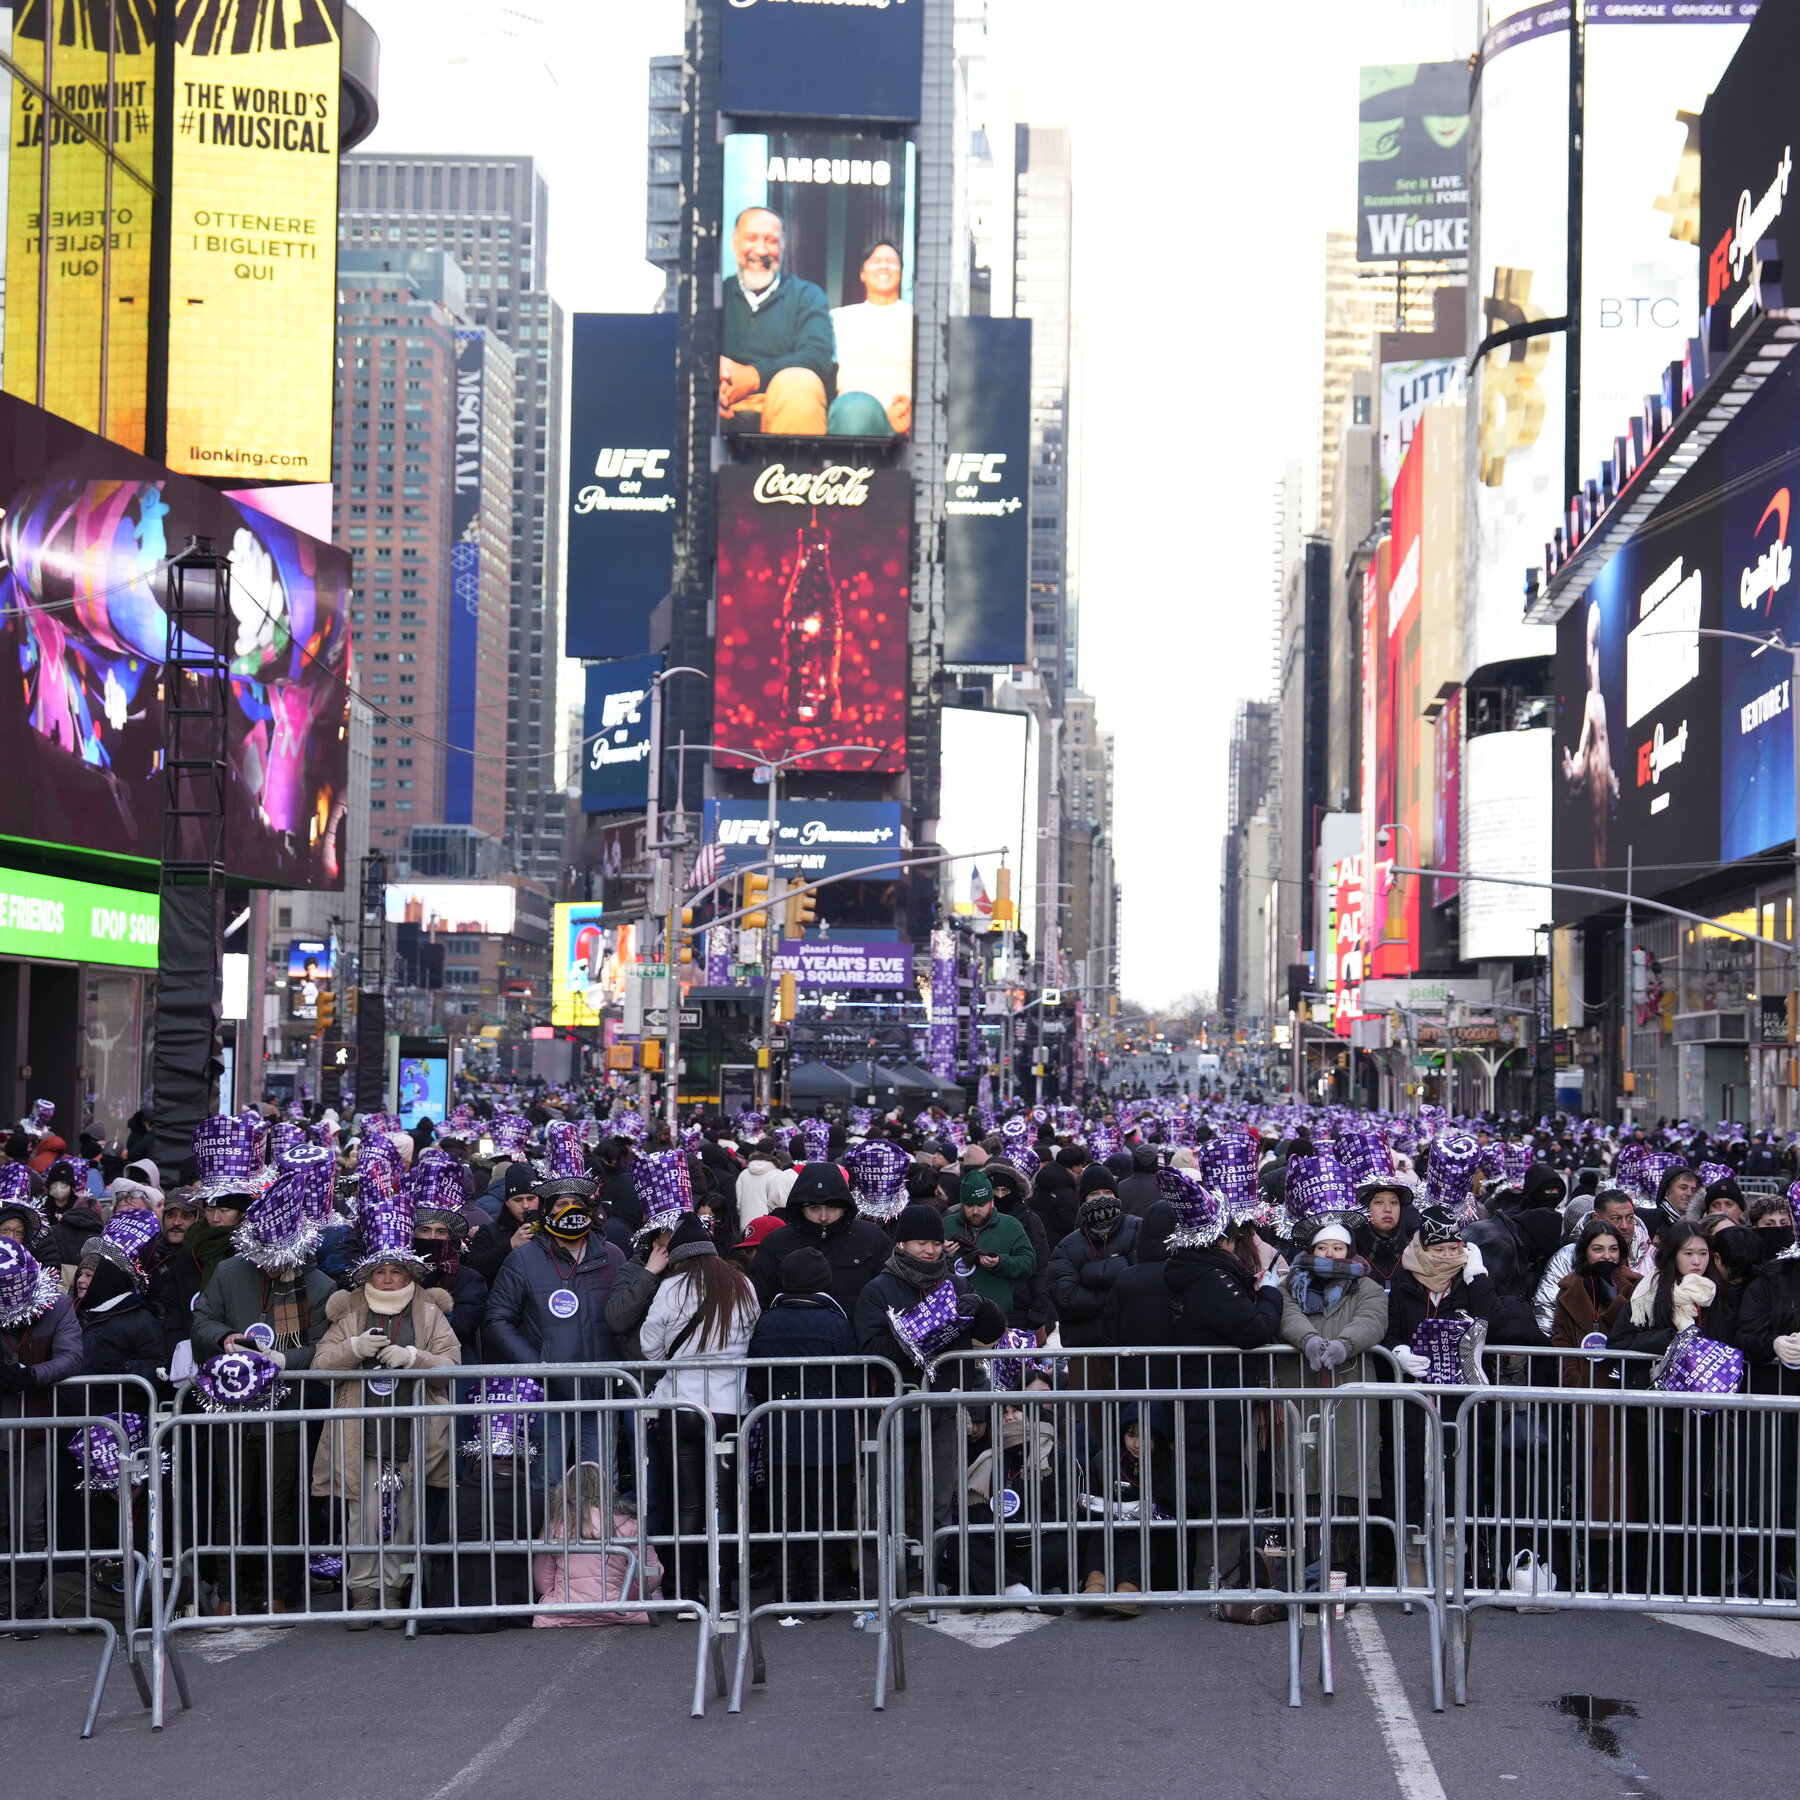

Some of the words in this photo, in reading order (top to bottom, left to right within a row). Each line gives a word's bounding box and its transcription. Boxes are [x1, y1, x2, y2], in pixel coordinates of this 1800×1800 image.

[185, 82, 224, 110] THE
[233, 86, 327, 118] WORLD'S
[180, 110, 205, 143] #1
[213, 113, 330, 154] MUSICAL
[767, 156, 891, 186] AMSUNG
[1436, 190, 1469, 204] FORE
[195, 211, 316, 234] OTTENERE
[207, 235, 316, 259] BIGLIETTI
[234, 263, 274, 281] QUI
[1600, 297, 1681, 329] BTC
[190, 446, 308, 466] lionking.com
[594, 448, 671, 478] UFC
[753, 463, 876, 507] Coca-Cola
[1740, 684, 1781, 735] VENTURE
[718, 819, 780, 846] UFC
[9, 895, 65, 935] FRIENDS
[91, 907, 127, 941] KPOP
[799, 944, 830, 955] planet
[831, 944, 864, 954] fitness
[771, 955, 799, 970] EW
[801, 956, 867, 971] YEAR'S
[869, 957, 905, 972] EVE
[806, 970, 867, 984] SQUARE
[867, 971, 904, 984] 2026
[650, 1013, 668, 1022] ONE
[498, 1124, 528, 1135] planet
[194, 1135, 232, 1153] planet
[198, 1147, 243, 1158] fitness
[360, 1145, 389, 1157] lanet
[564, 1138, 583, 1151] pla
[853, 1164, 894, 1175] planet
[858, 1172, 901, 1181] fitness
[1212, 1164, 1257, 1178] planet
[441, 1176, 463, 1192] plan
[1291, 1171, 1336, 1199] planet
[1298, 1182, 1346, 1201] fitness
[443, 1187, 462, 1203] fitn
[1160, 1190, 1181, 1199] lanet
[253, 1199, 296, 1228] planet
[258, 1203, 301, 1232] fitness
[381, 1211, 414, 1226] plan
[110, 1217, 149, 1231] planet
[112, 1221, 150, 1243] fitness
[389, 1220, 414, 1235] fitn
[1441, 1330, 1451, 1384] fitness
[1685, 1345, 1721, 1386] fitness
[1699, 1345, 1736, 1385] planet
[473, 1390, 522, 1404] panet
[91, 1429, 142, 1460] plaet
